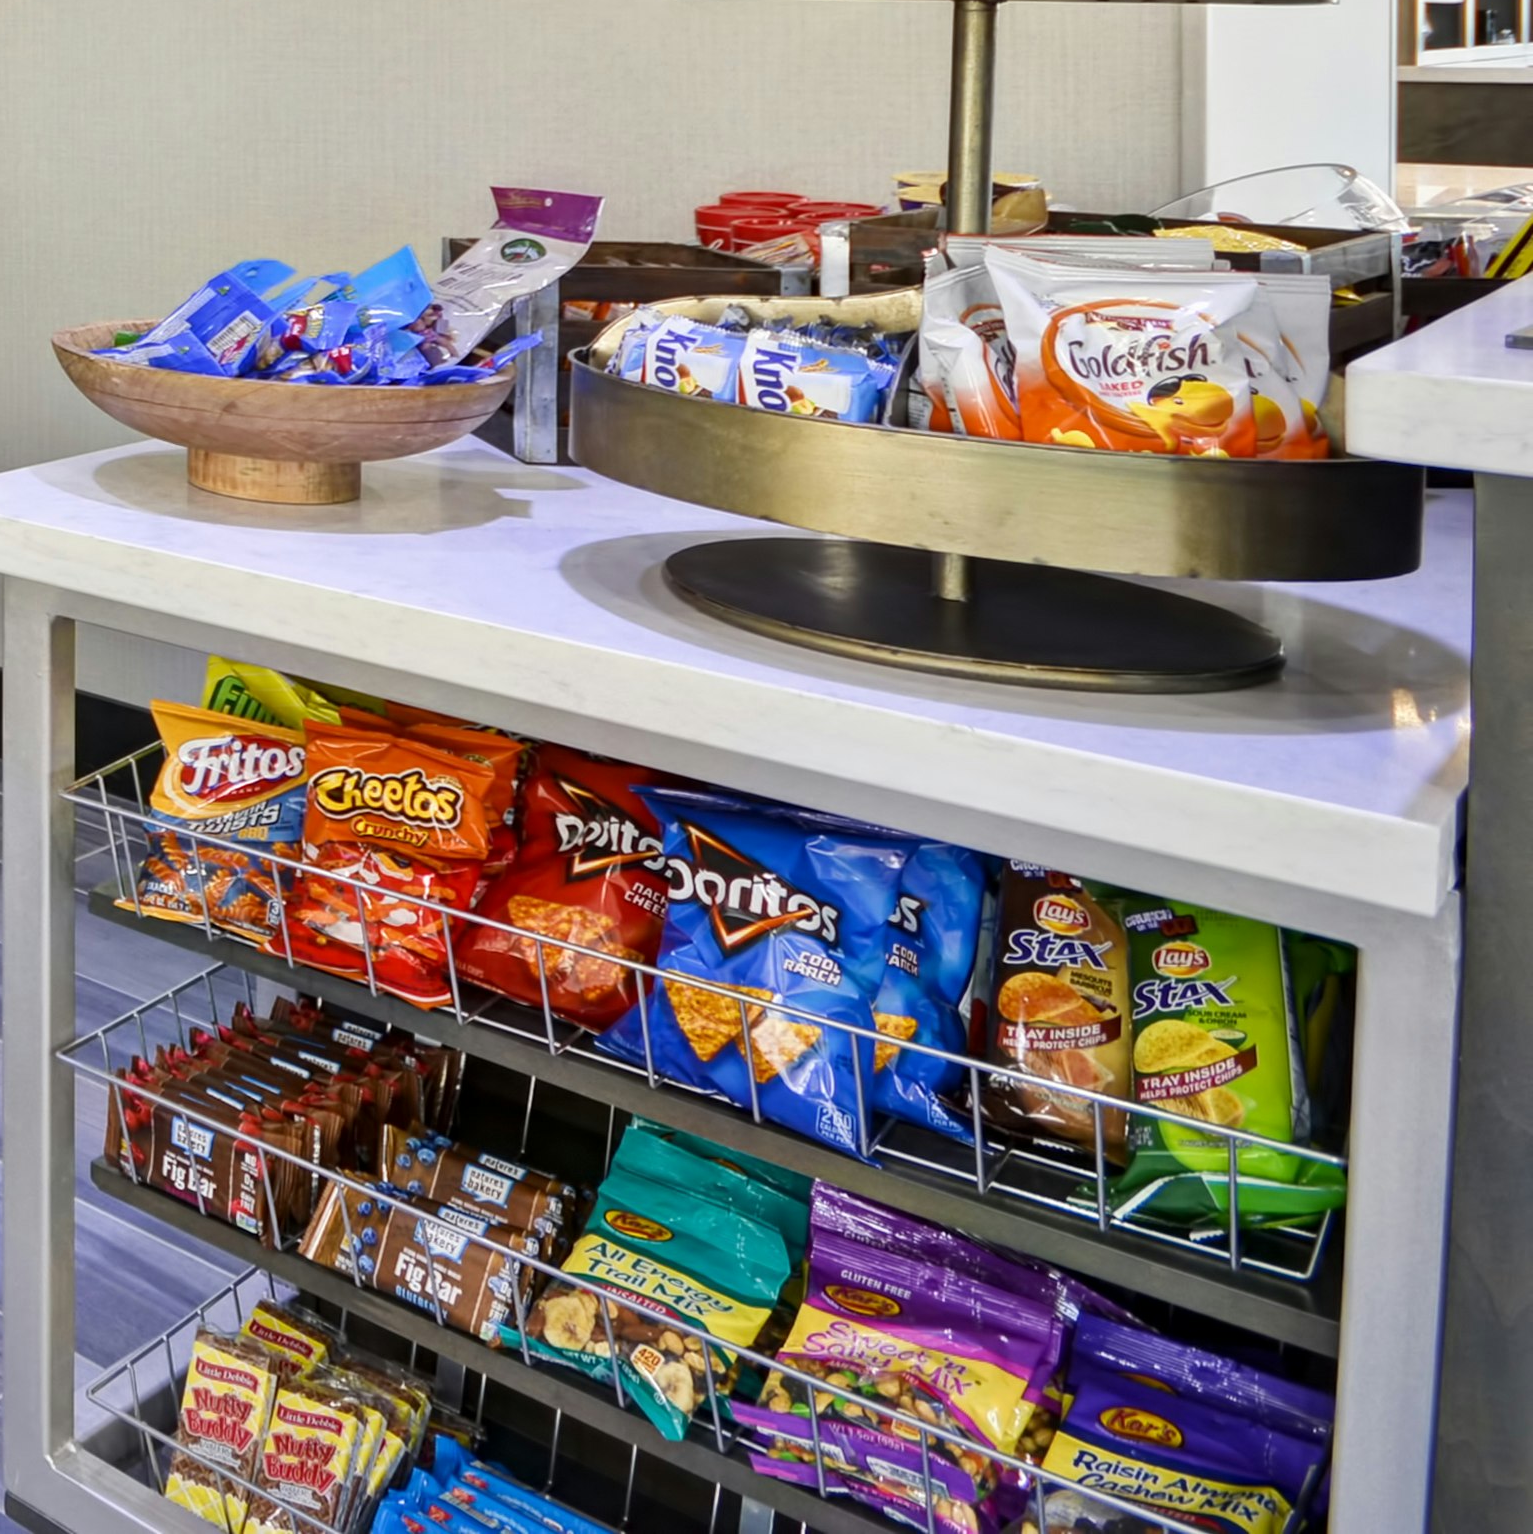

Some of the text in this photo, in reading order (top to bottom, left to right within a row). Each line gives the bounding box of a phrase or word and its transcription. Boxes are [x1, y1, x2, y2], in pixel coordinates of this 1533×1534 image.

[1067, 333, 1210, 380] Goldfish
[177, 735, 305, 795] Fritos
[313, 768, 457, 822] Cheetos
[351, 817, 429, 845] Crunchy
[623, 890, 668, 919] CHEES
[632, 881, 669, 905] NACH
[668, 857, 838, 942] Doritos
[1038, 900, 1086, 926] Lay's
[798, 950, 841, 974] COOL
[890, 943, 919, 967] COOL
[1157, 948, 1208, 969] Lay's
[783, 958, 842, 986] RANCH
[1070, 970, 1113, 988] MESQUITE
[1187, 1009, 1248, 1019] SOUR CREAM
[1006, 1023, 1102, 1041] TRAY INSIDE
[1033, 1037, 1076, 1051] PROTECT
[1077, 1032, 1108, 1048] CHIPS
[1139, 1065, 1243, 1101] HELPS PROTECT CHIPS
[1141, 1057, 1236, 1090] TRAY INSIDE
[161, 1154, 187, 1191] Fig
[187, 1168, 218, 1200] Bar
[466, 1177, 504, 1201] bakery
[610, 1212, 669, 1238] Kar's
[393, 1251, 429, 1293] Fig
[423, 1273, 463, 1306] Bar
[584, 1241, 735, 1313] All Energy
[588, 1256, 712, 1317] Trail Mix
[840, 1269, 911, 1300] GLUTEN FREE
[252, 1322, 309, 1355] Little Debbie
[829, 1320, 932, 1365] Sweet
[636, 1346, 662, 1367] 420
[802, 1331, 972, 1396] Salty Mix
[197, 1363, 255, 1388] Little Debbie
[192, 1386, 253, 1425] Nutty
[280, 1409, 340, 1433] Little Debbie
[184, 1408, 254, 1455] Buddy
[1109, 1409, 1177, 1443] Kar's
[271, 1432, 337, 1467] Nutty
[263, 1453, 337, 1496] Buddy
[1072, 1449, 1160, 1485] Raisin
[1076, 1473, 1259, 1523] Cashew Mix
